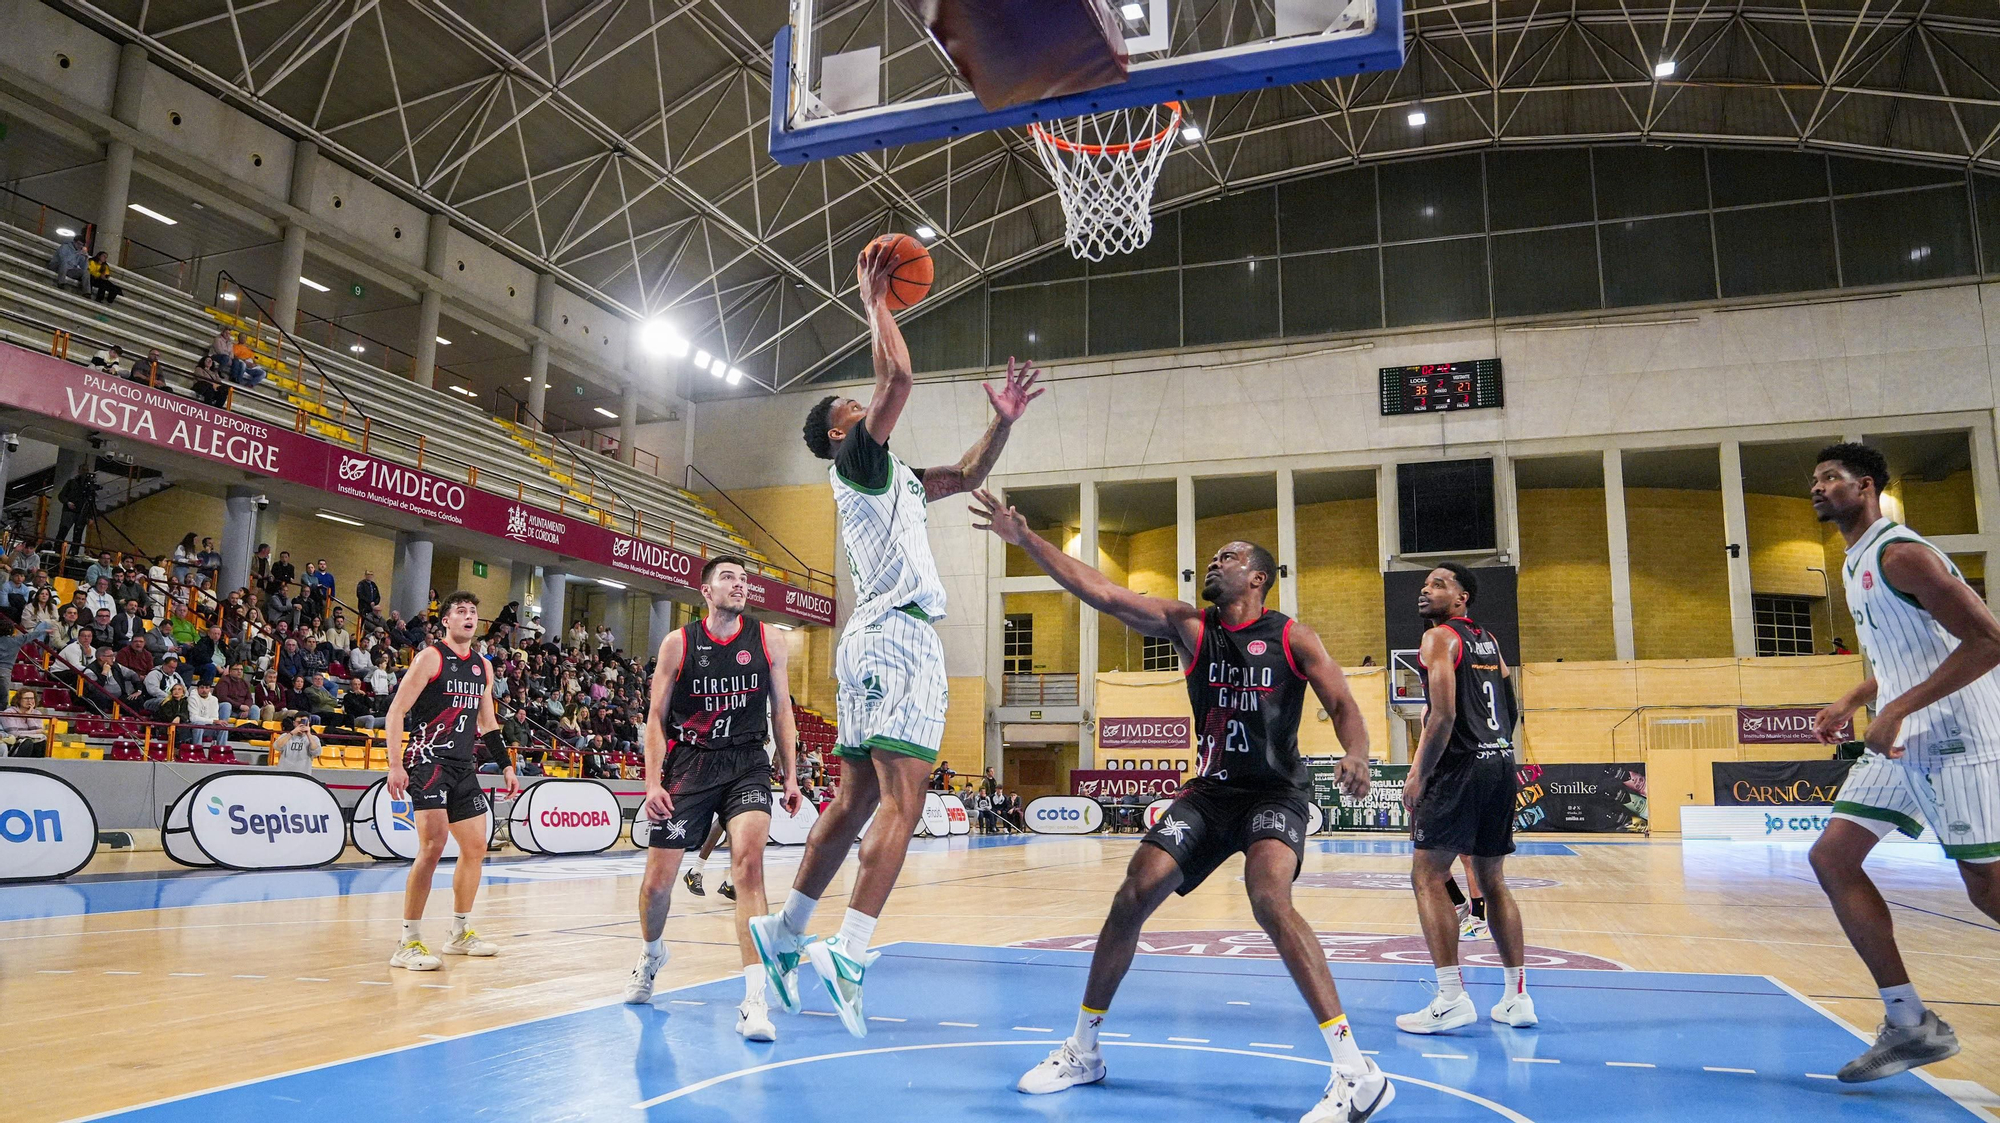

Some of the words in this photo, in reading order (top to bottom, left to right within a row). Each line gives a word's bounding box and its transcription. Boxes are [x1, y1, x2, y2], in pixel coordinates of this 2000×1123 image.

[355, 286, 361, 296] 9
[576, 386, 583, 395] 10
[1416, 386, 1428, 396] 35
[1458, 382, 1470, 392] 27
[84, 374, 142, 401] PALACIO
[145, 393, 210, 423] MUNICIPAL
[214, 414, 268, 439] DEPORTES
[65, 386, 158, 440] VISTA
[167, 419, 280, 473] ALEGRE
[370, 462, 465, 511] IMDECO
[338, 484, 366, 498] Instituto
[366, 491, 398, 508] Municipal
[400, 501, 408, 510] de
[410, 502, 437, 520] Deportes
[438, 508, 463, 525] Córdoba
[528, 515, 566, 535] AYUNTAMIENTO
[527, 529, 534, 538] DE
[534, 528, 560, 546] CÓRDOBA
[632, 540, 691, 576] IMDECO
[612, 559, 630, 570] Instituto
[630, 564, 650, 576] Municipal
[650, 569, 656, 577] de
[656, 570, 673, 583] Deportes
[674, 575, 689, 586] Córdoba
[796, 592, 831, 615] IMDECO
[446, 678, 484, 696] CÍRCULO
[693, 673, 758, 694] CÍRCULO
[452, 694, 479, 710] GIJÓN
[705, 692, 747, 712] GIJÓN
[1482, 680, 1500, 730] 3
[712, 716, 732, 739] 21
[1122, 724, 1187, 737] IMDECO
[1766, 716, 1848, 731] IMDE
[1101, 779, 1178, 795] IMDECO
[1550, 782, 1597, 794] Smilke
[228, 804, 330, 843] Sepisur
[540, 807, 611, 828] CÓRDOBA
[1037, 807, 1080, 820] coto
[0, 808, 63, 843] on
